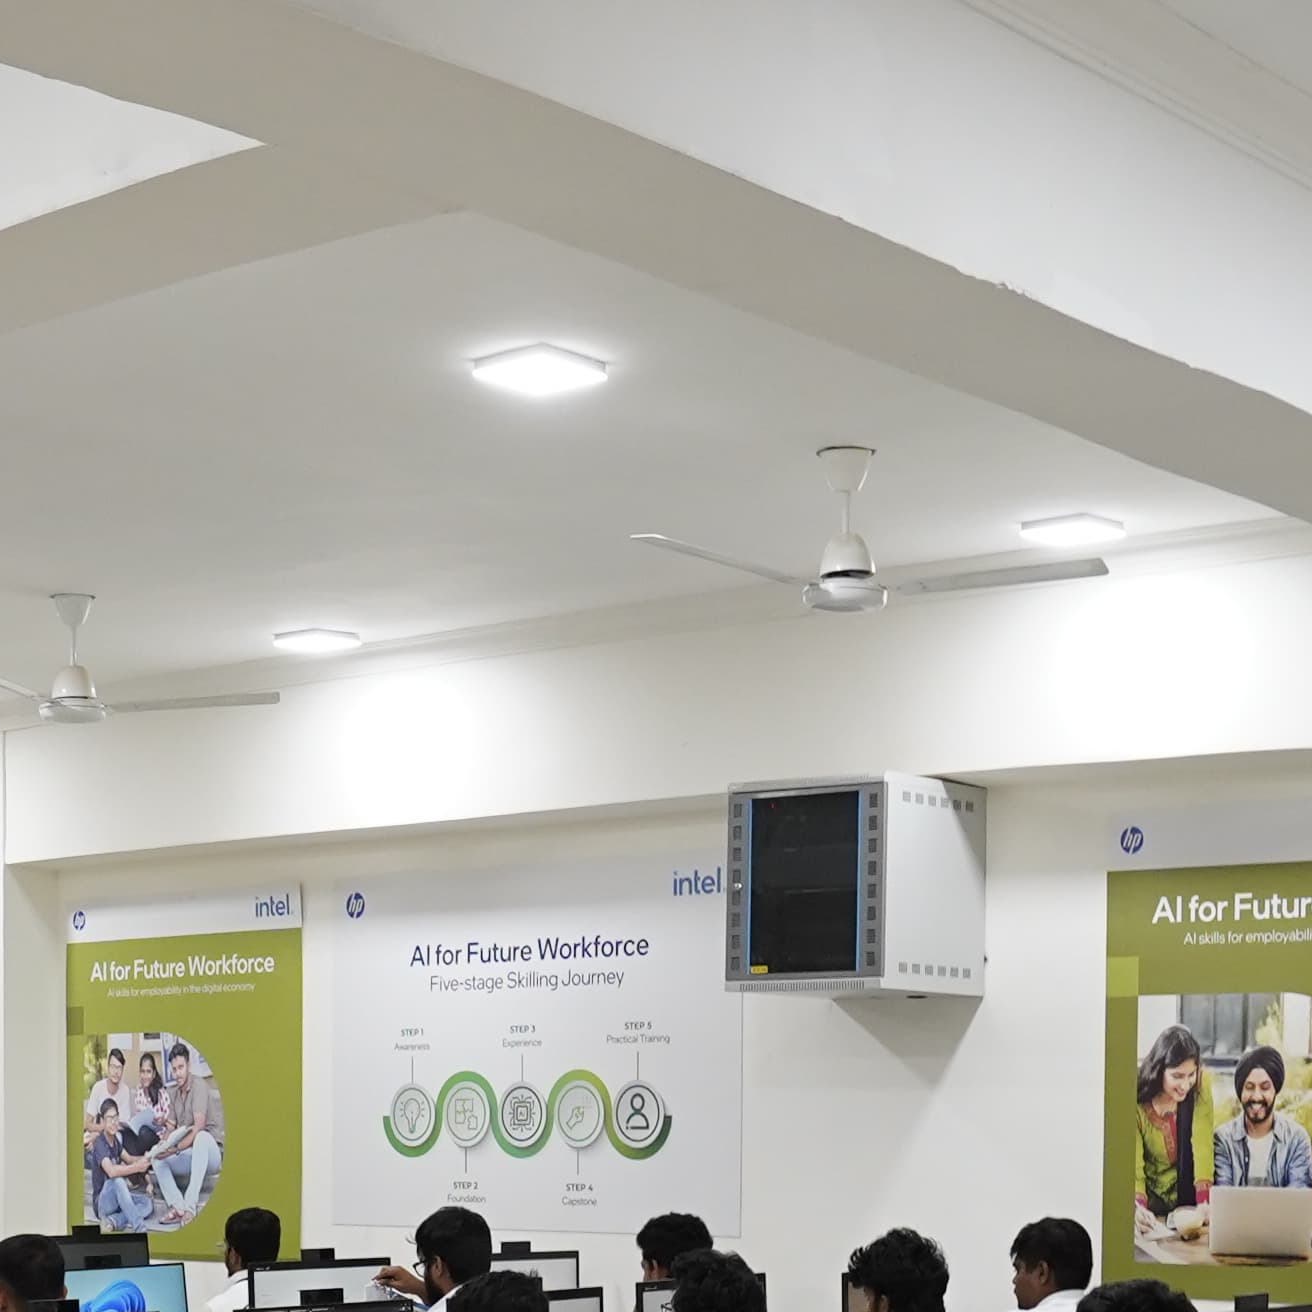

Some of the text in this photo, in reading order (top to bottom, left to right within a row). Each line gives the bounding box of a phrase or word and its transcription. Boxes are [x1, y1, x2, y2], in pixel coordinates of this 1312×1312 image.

[1120, 826, 1144, 854] hp
[673, 867, 721, 896] intel
[255, 894, 290, 917] intel
[346, 892, 365, 919] hp
[1152, 896, 1182, 924] AI
[1189, 894, 1228, 922] for
[1184, 932, 1197, 945] AI
[1199, 931, 1225, 944] skills
[1228, 930, 1244, 943] for
[410, 935, 649, 967] AI for Future Workforce
[90, 954, 275, 982] AI for Future Workforce
[430, 969, 625, 994] Five-stage Skilling Journey
[510, 1025, 536, 1033] STEP 3
[624, 1022, 644, 1030] STEP
[401, 1029, 417, 1037] STEP
[502, 1039, 542, 1048] Experience
[607, 1034, 671, 1044] Practical Training
[394, 1043, 430, 1051] Awareness
[453, 1181, 472, 1190] STEP
[566, 1184, 585, 1192] STEP
[447, 1194, 486, 1203] Foundation
[561, 1197, 597, 1207] Capstone
